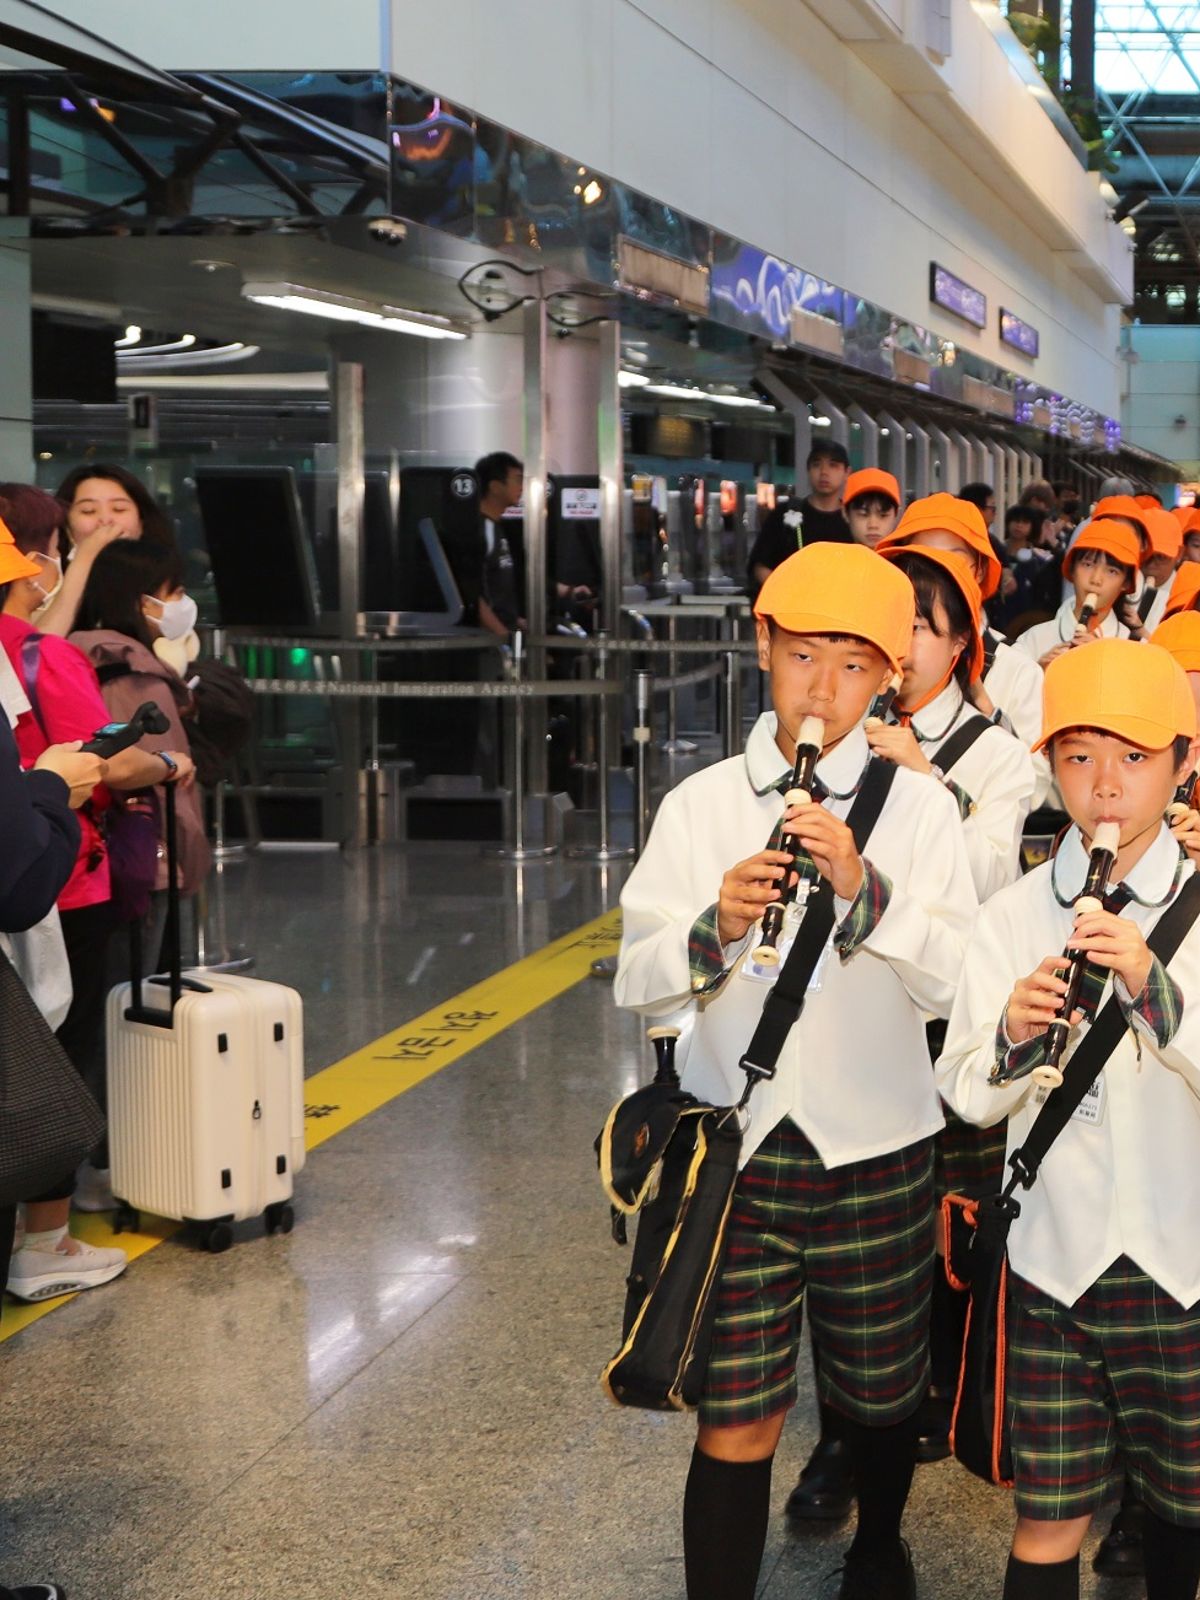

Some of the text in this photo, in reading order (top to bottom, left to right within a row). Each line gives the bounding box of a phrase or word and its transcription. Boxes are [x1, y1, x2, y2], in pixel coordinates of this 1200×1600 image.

[454, 479, 473, 493] 13
[328, 682, 534, 696] National Immigration Agency
